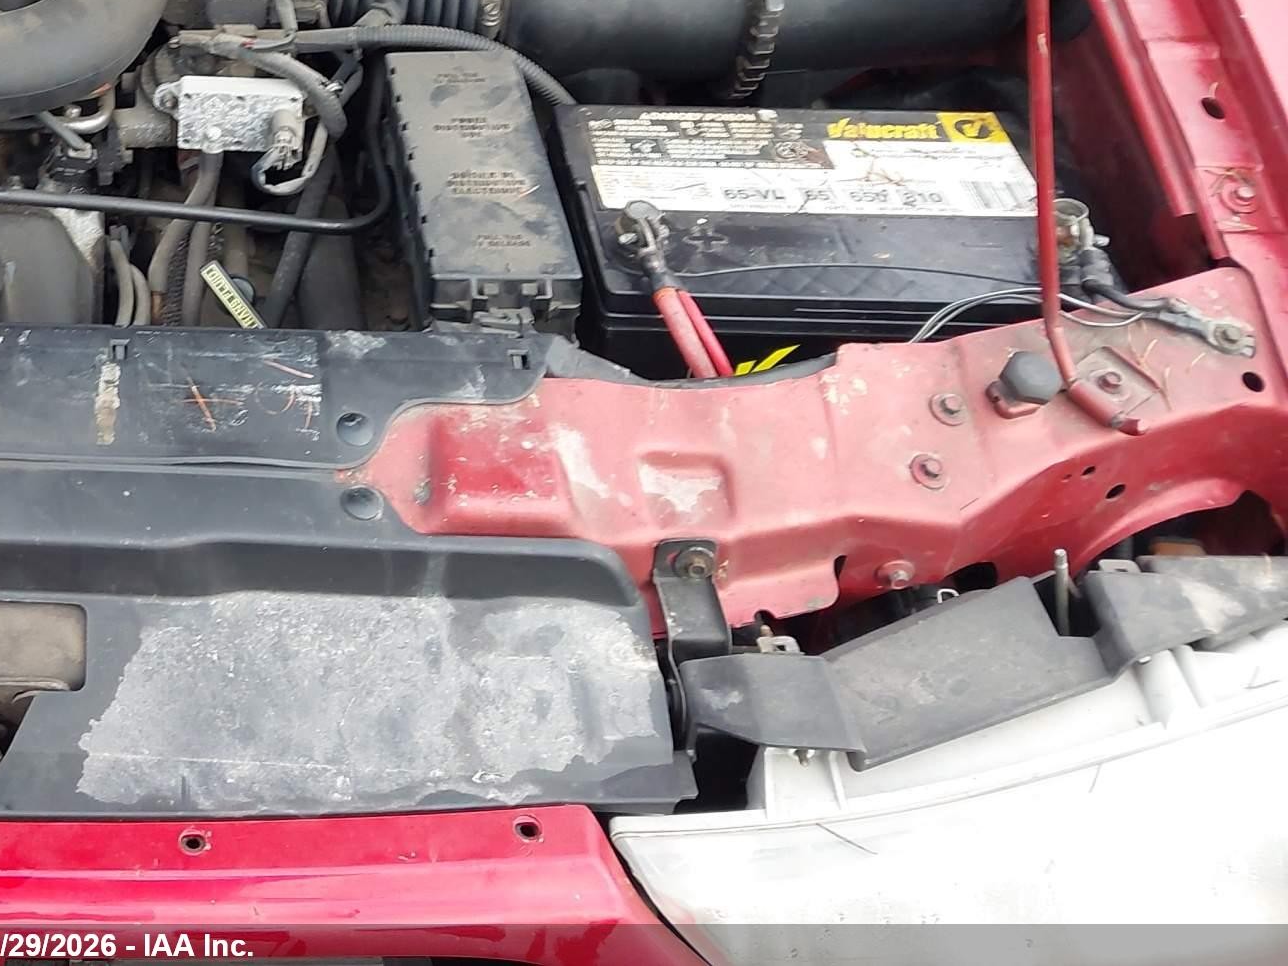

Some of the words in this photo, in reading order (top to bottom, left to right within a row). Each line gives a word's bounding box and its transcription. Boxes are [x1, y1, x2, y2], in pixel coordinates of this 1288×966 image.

[826, 117, 940, 140] Valucraft
[723, 188, 787, 201] 65-VL
[806, 188, 830, 202] 65
[206, 270, 232, 298] FLUID
